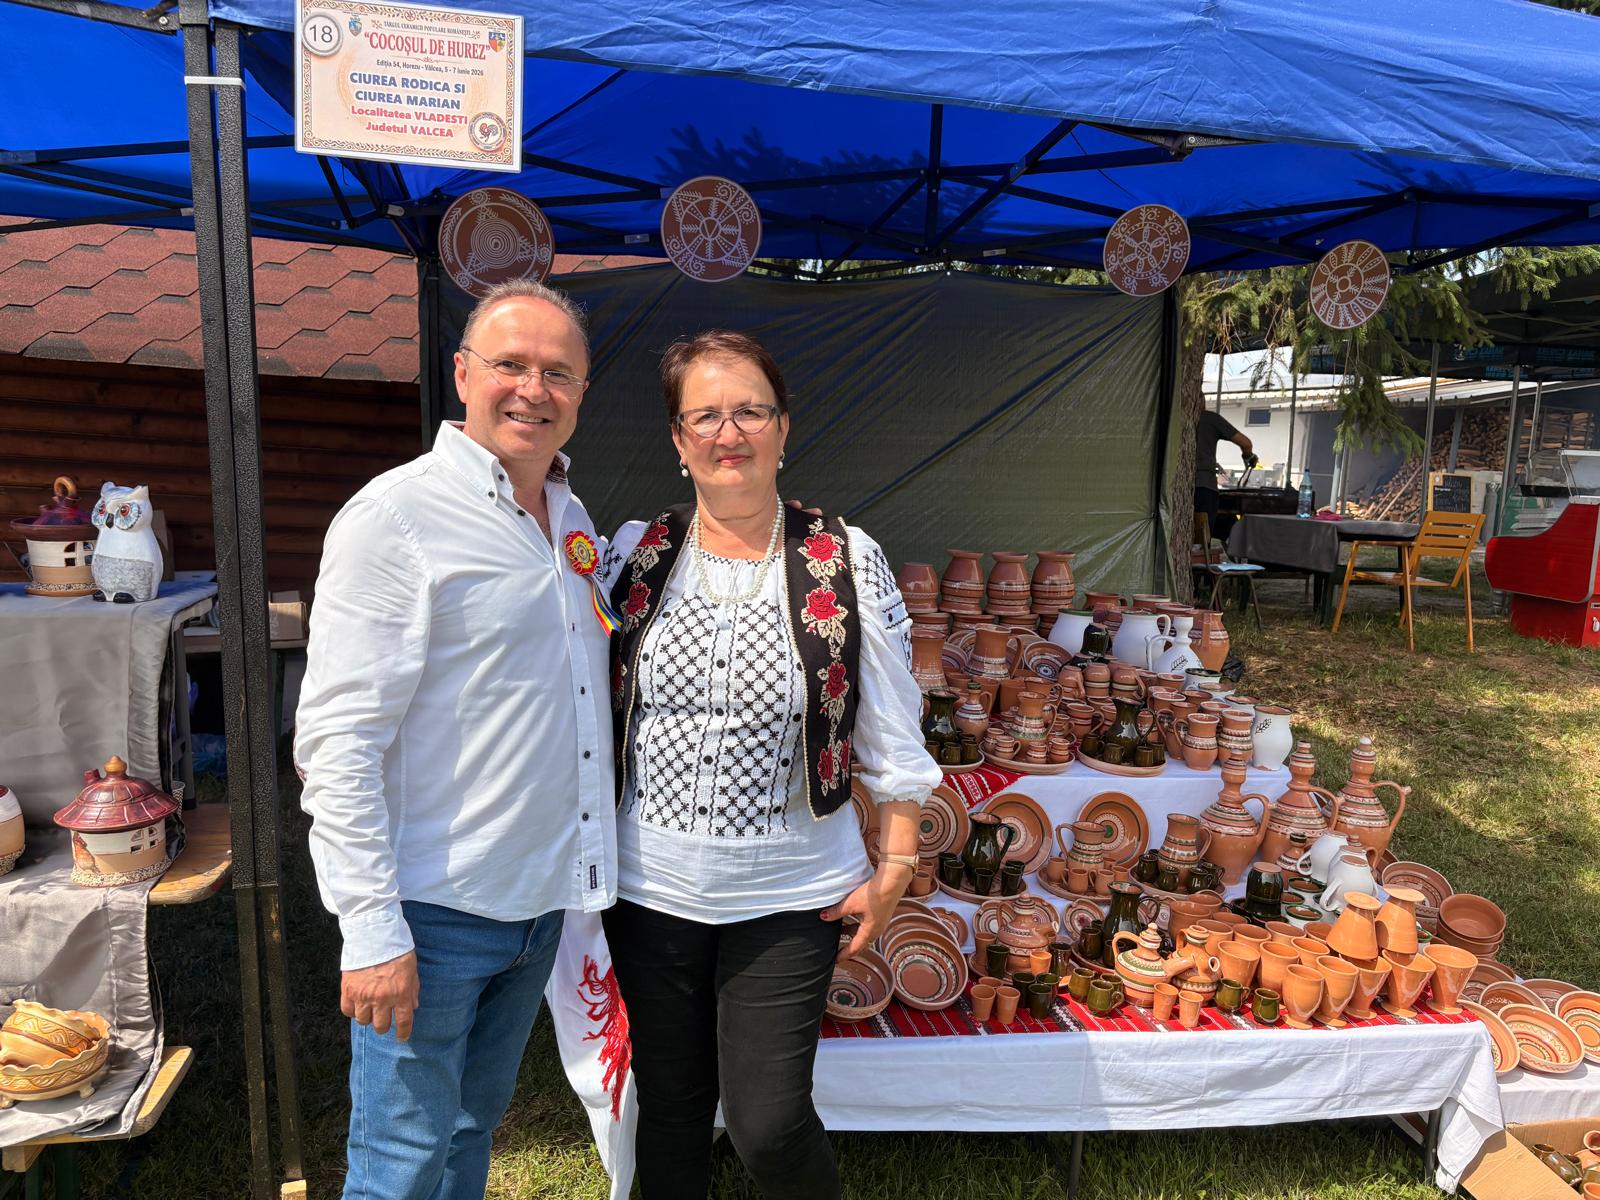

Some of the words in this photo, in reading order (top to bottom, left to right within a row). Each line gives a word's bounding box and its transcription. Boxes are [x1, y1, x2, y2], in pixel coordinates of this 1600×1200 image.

[309, 24, 333, 43] 18
[429, 38, 445, 56] DE
[393, 61, 401, 69] 54,
[350, 73, 397, 87] CIUREA
[401, 78, 450, 92] RODICA
[454, 84, 466, 93] SI
[355, 91, 402, 105] CIUREA
[406, 95, 461, 110] MARIAN
[351, 106, 411, 119] Localitatea
[414, 111, 468, 124] VLADESTI
[366, 122, 407, 133] Judetul
[410, 126, 454, 137] VALCEA
